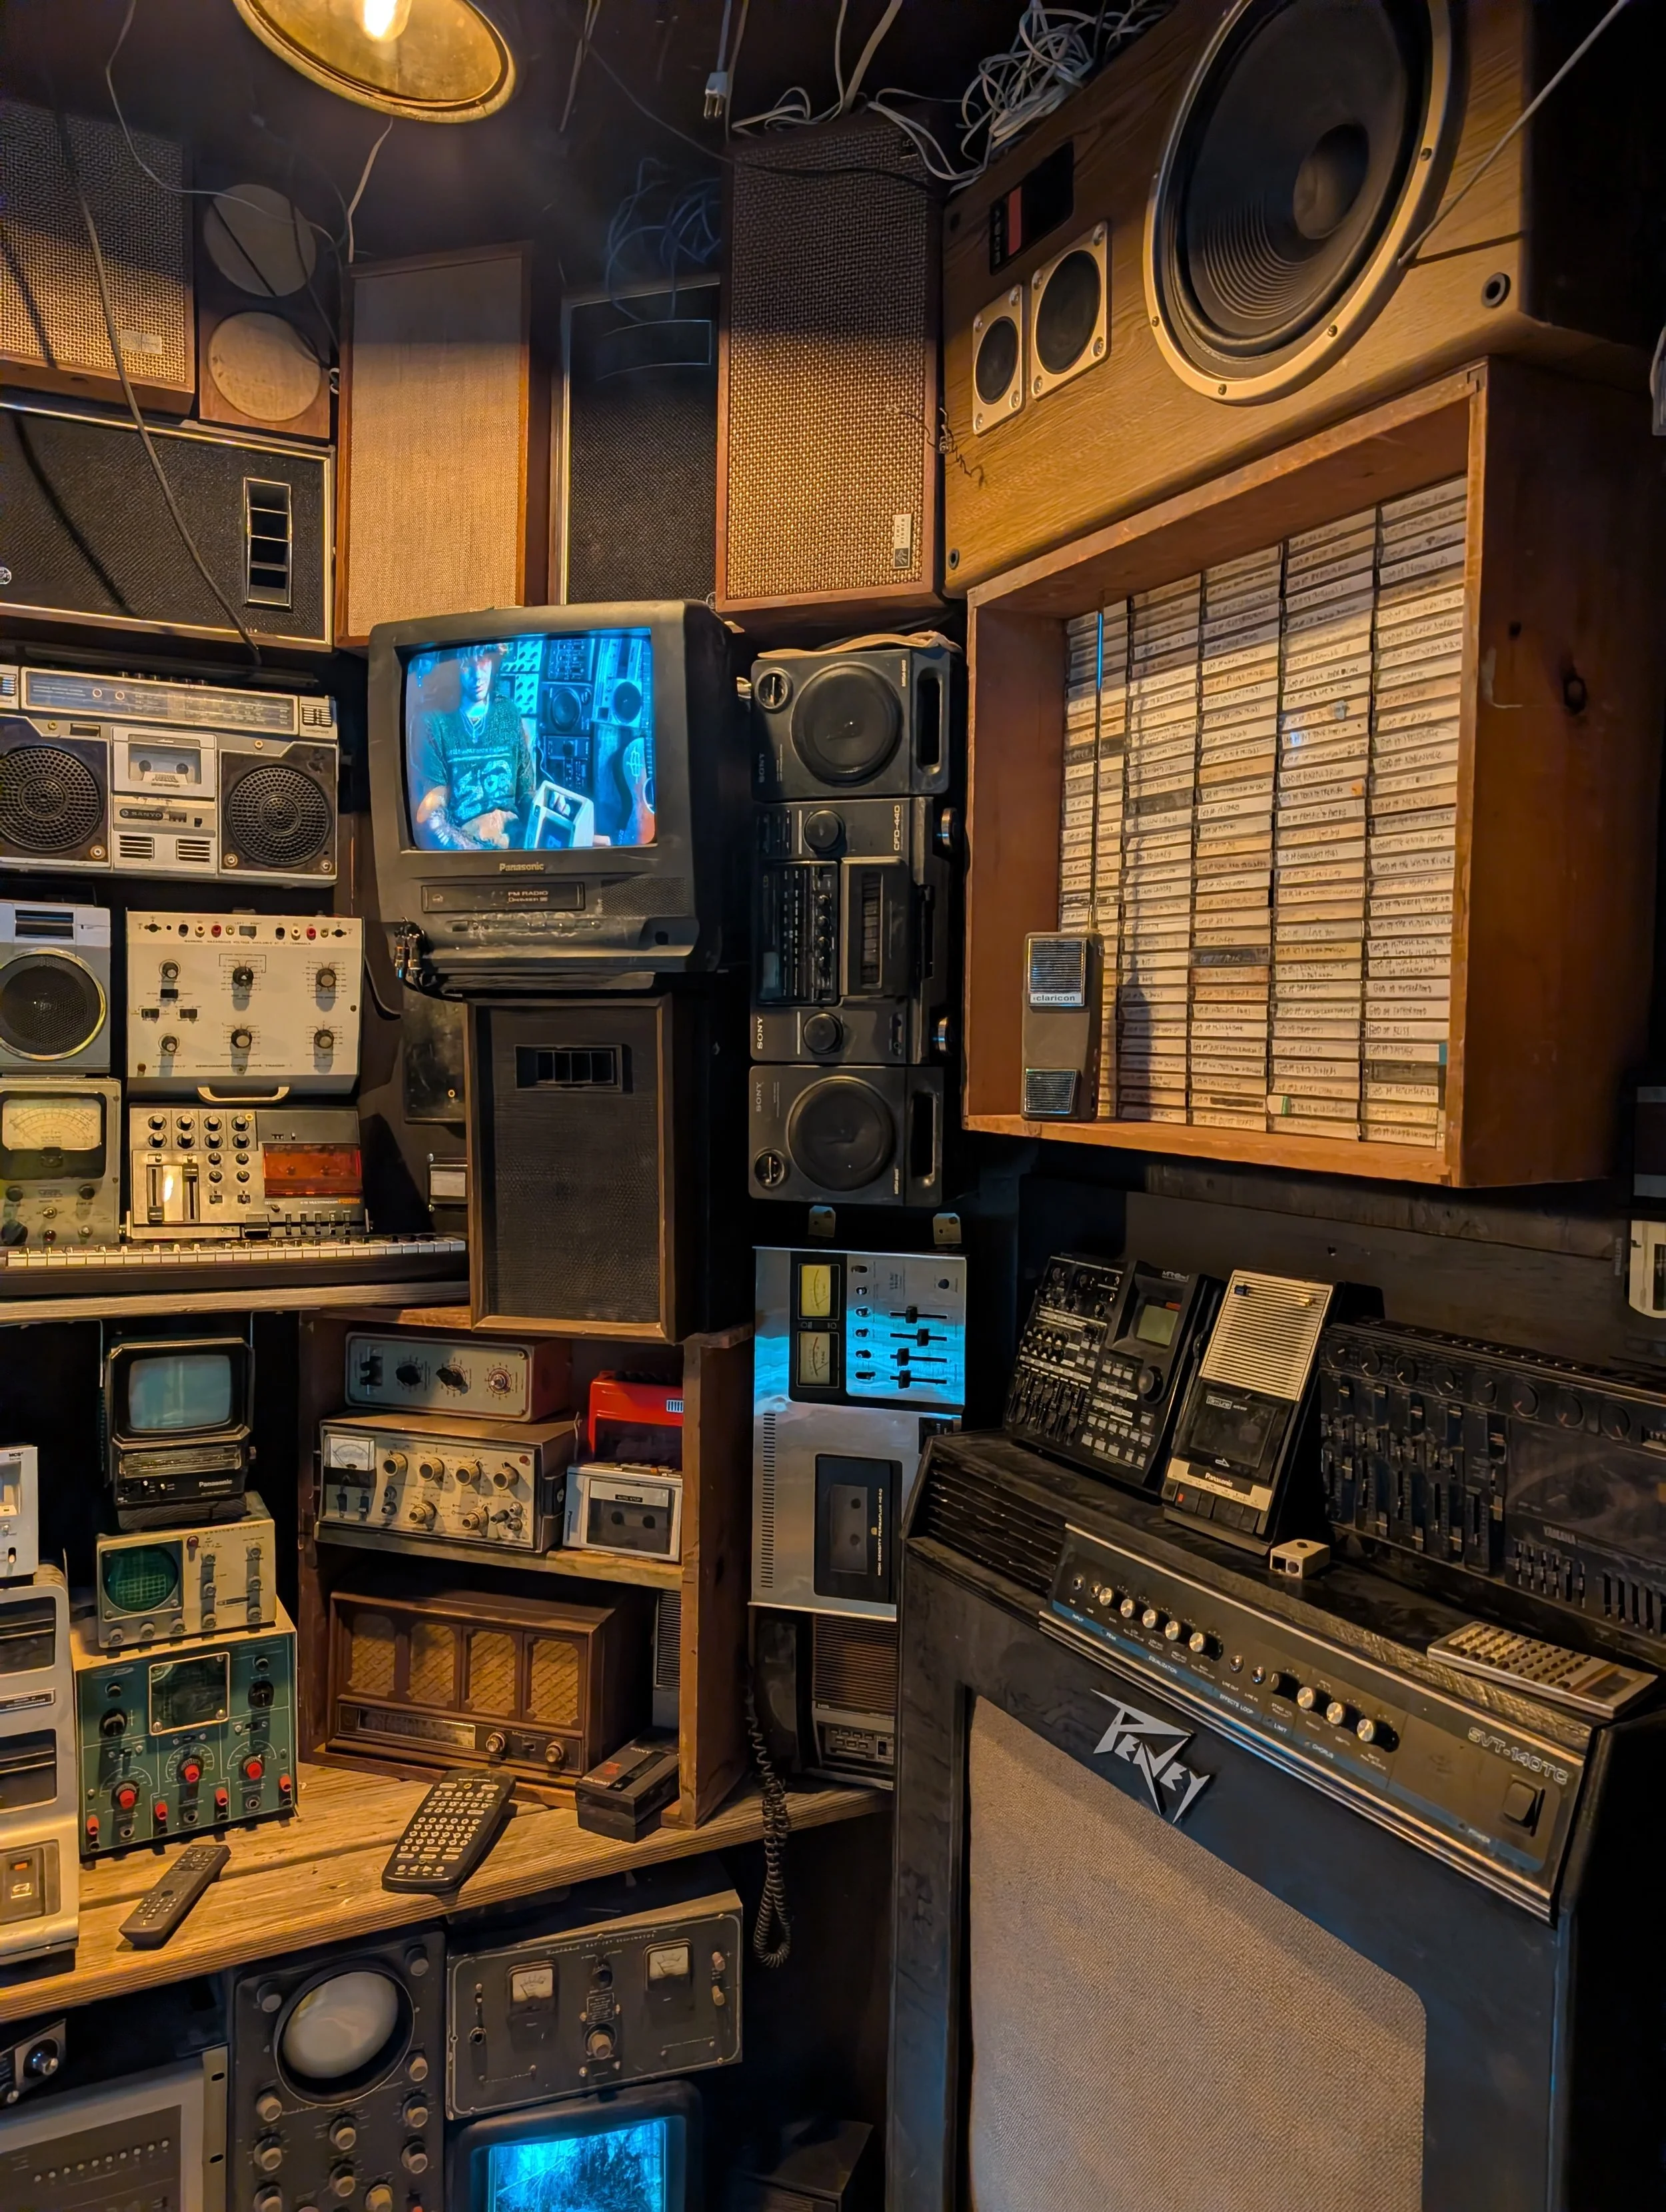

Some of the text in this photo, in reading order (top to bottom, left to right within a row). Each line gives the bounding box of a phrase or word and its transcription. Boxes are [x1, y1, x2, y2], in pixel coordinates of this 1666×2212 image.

[499, 861, 544, 871] Panasonic
[1410, 857, 1429, 867] WHITE
[1431, 855, 1451, 865] RIVER
[1036, 993, 1076, 1002] claricon
[1369, 1025, 1381, 1034] GOD
[1393, 1025, 1409, 1036] BLISS
[199, 1479, 233, 1488] Panasonic
[1205, 1472, 1233, 1487] Panasonic
[1543, 1524, 1576, 1546] YAMAHA
[1148, 1655, 1178, 1674] EQUALIZATION
[1220, 1693, 1253, 1714] EFFECTS LOOP
[1273, 1722, 1287, 1733] LIMIT
[1311, 1743, 1335, 1759] CHORUS
